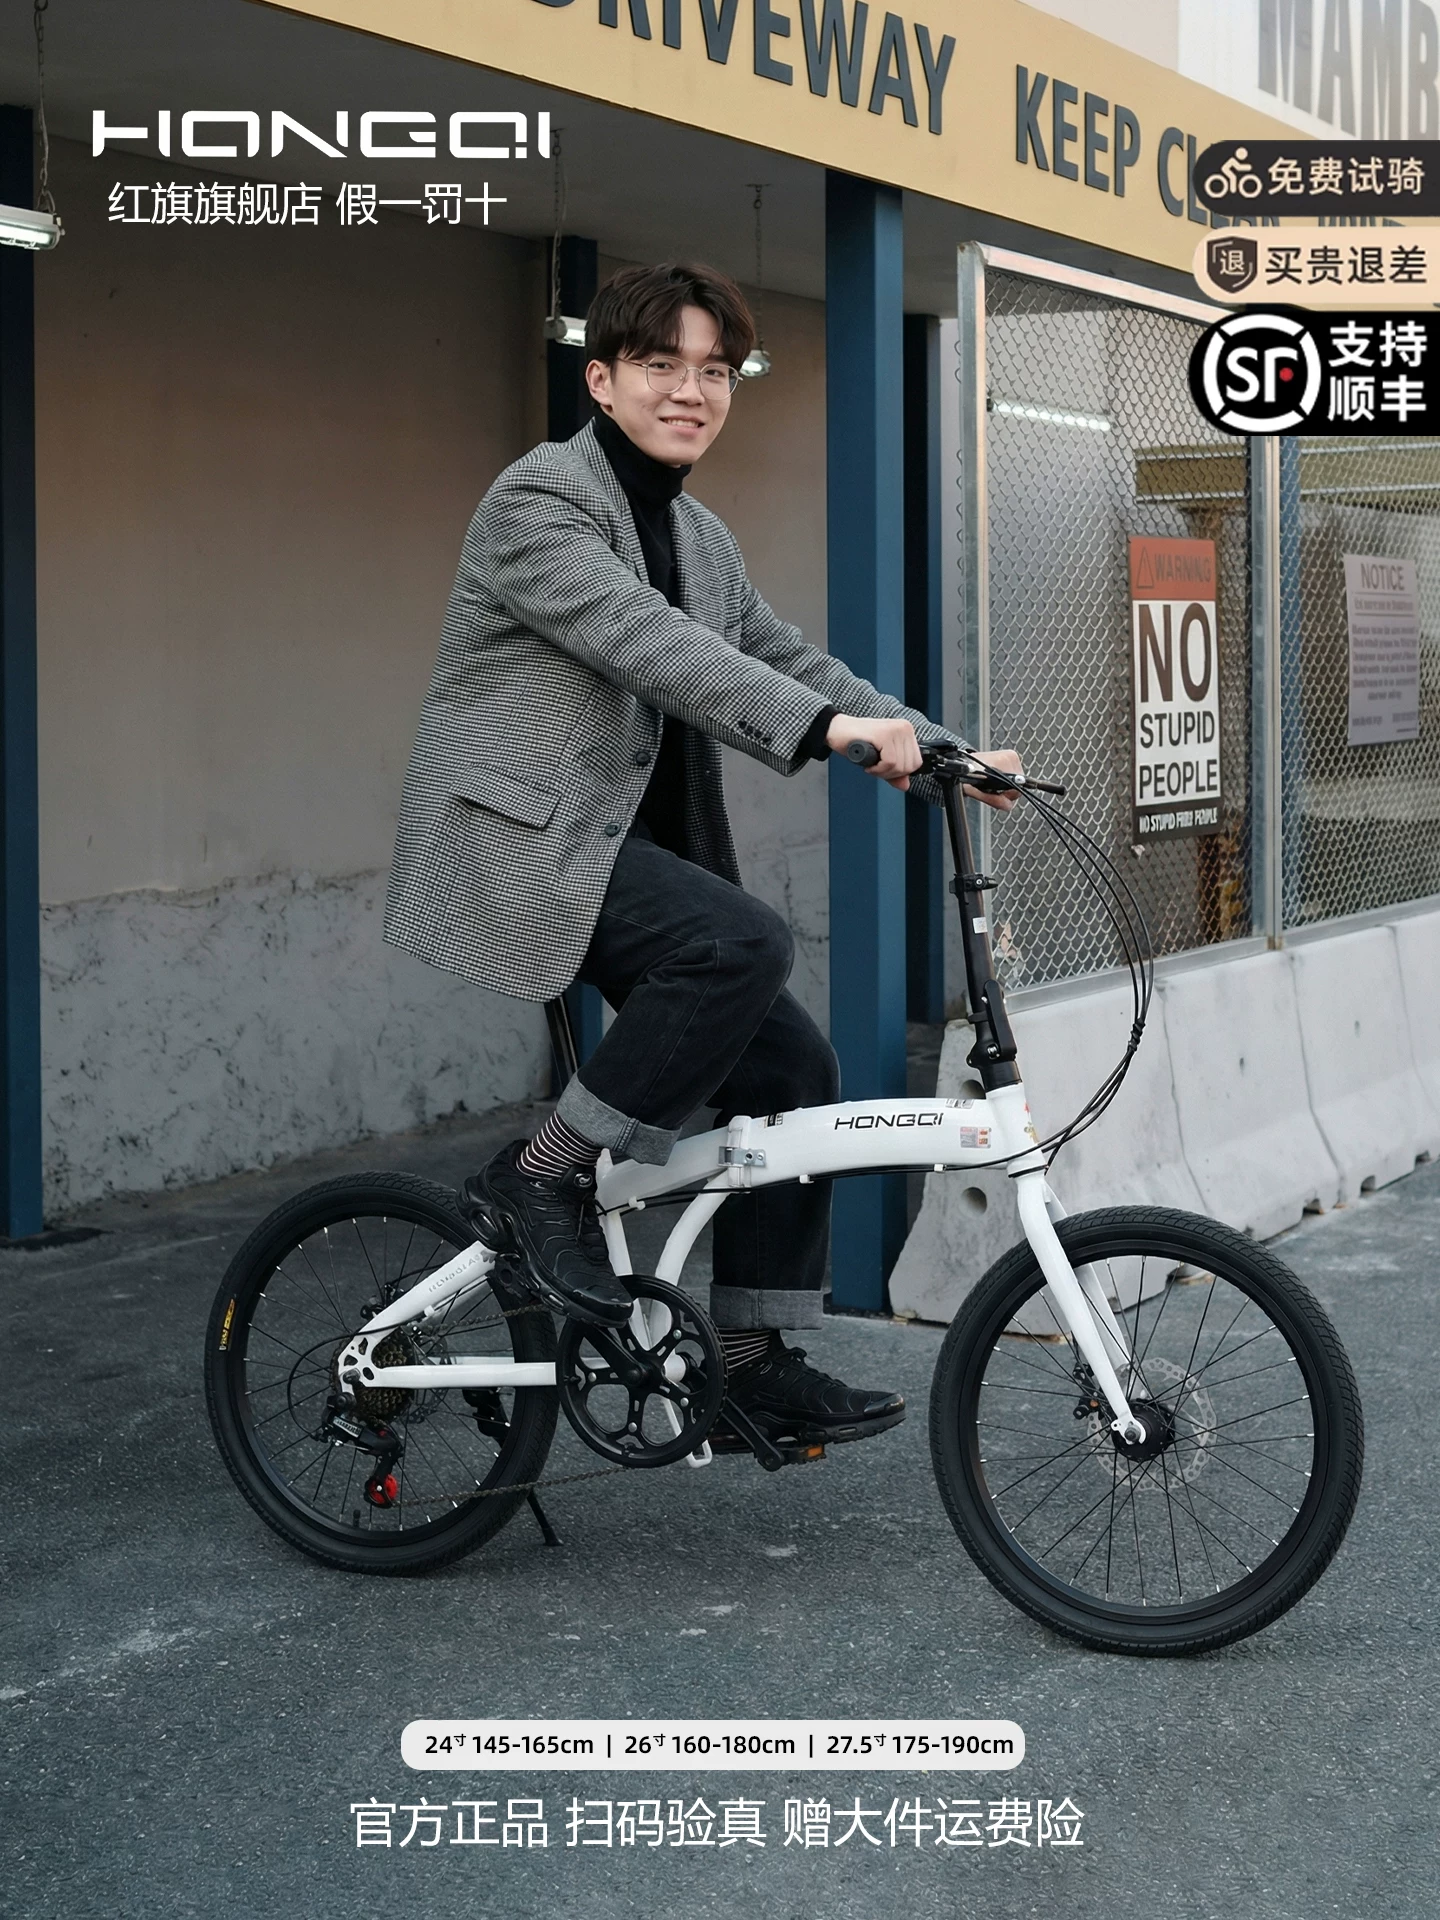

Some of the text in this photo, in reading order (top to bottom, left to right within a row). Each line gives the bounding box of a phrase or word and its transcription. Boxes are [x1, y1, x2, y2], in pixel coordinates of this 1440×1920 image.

[1016, 64, 1141, 198] KEEP
[1154, 553, 1211, 583] WARNING
[1360, 563, 1405, 591] NOTICE
[1138, 602, 1212, 704] NO
[1140, 710, 1215, 749] STUPID
[1139, 759, 1218, 799] PEOPLE
[834, 1113, 944, 1130] HONGQI
